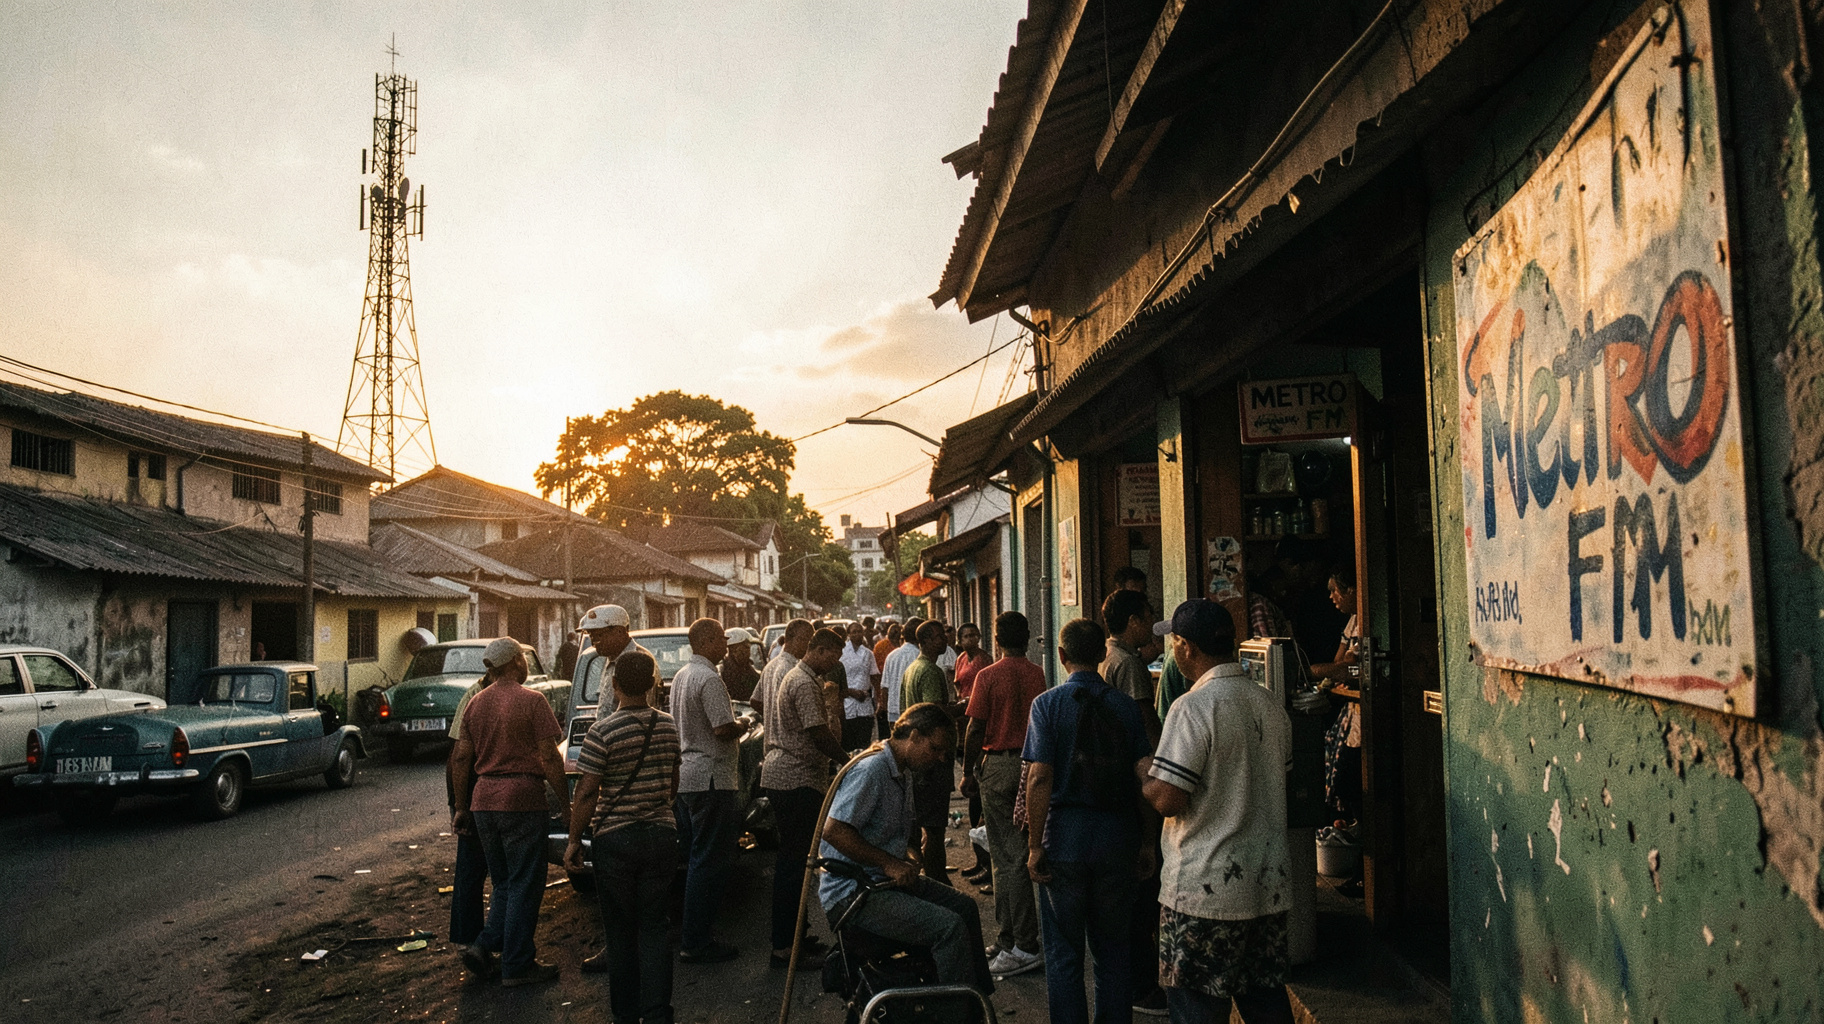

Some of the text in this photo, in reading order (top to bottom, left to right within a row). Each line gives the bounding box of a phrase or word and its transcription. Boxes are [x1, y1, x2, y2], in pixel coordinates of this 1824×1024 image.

[1251, 380, 1347, 410] METRO
[1306, 407, 1346, 430] FM
[1567, 493, 1687, 644] FM
